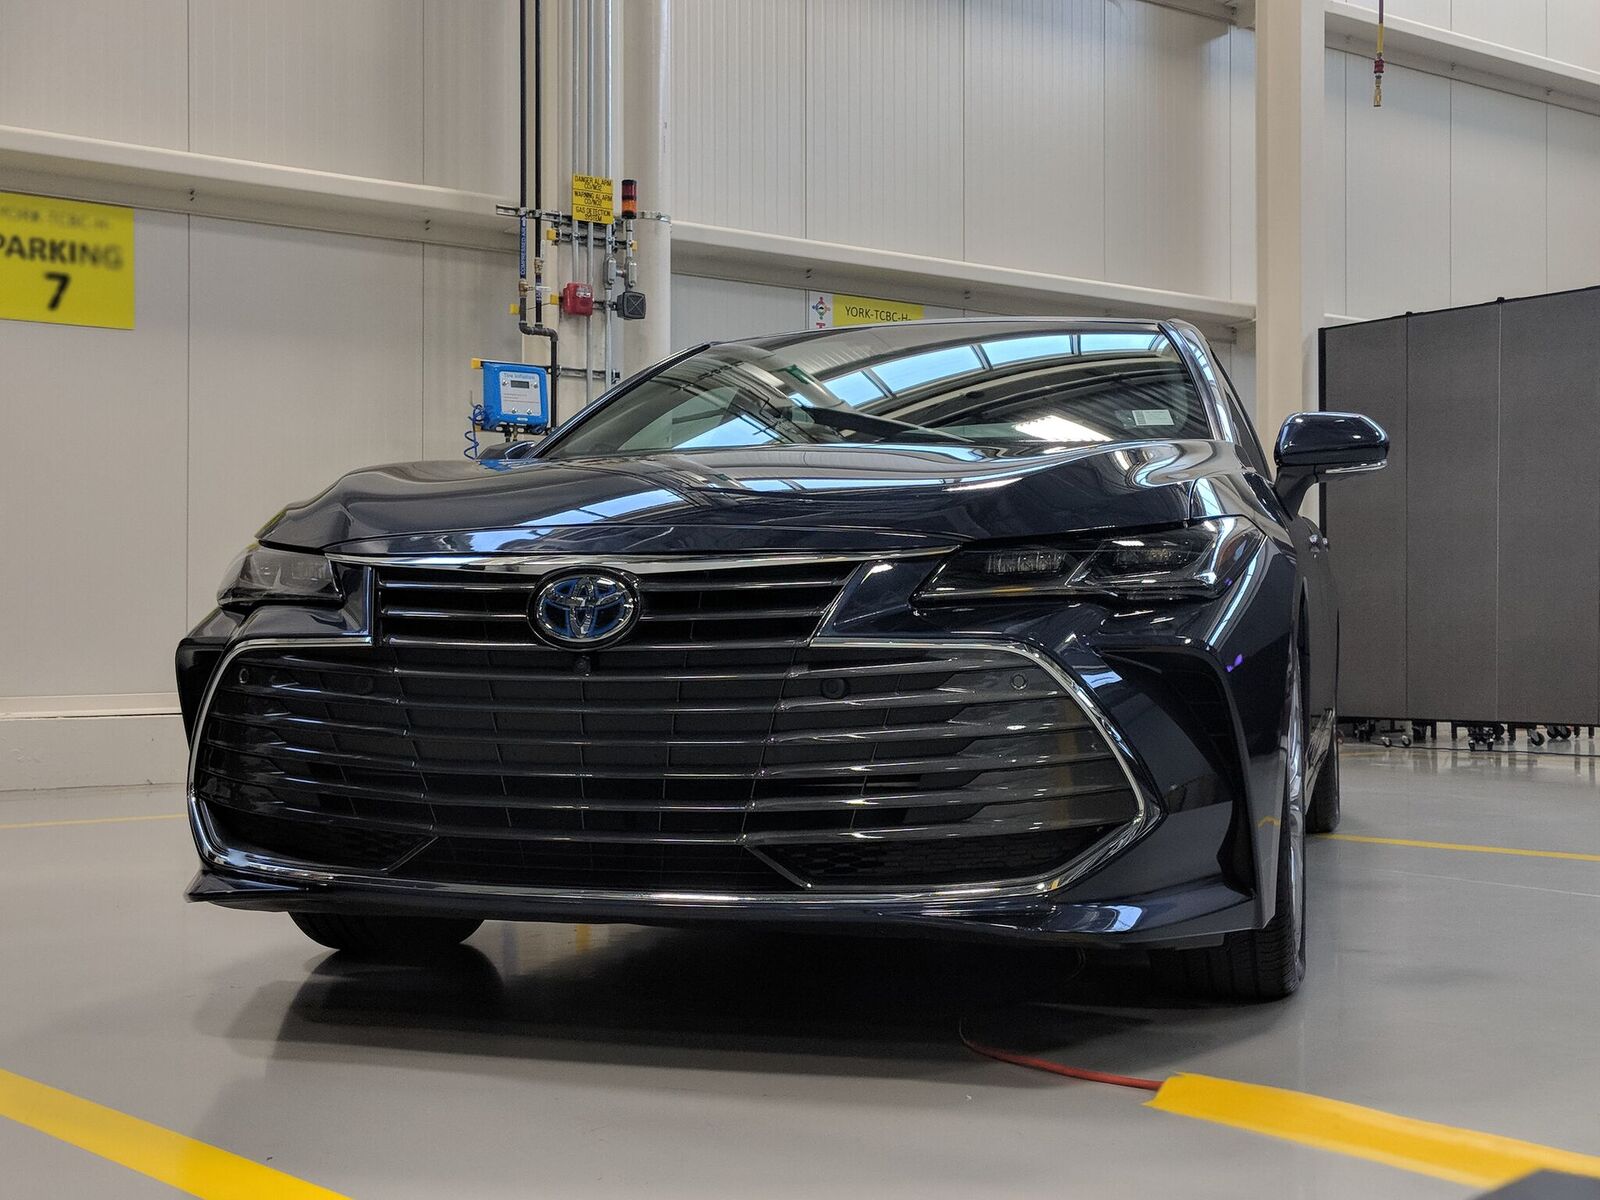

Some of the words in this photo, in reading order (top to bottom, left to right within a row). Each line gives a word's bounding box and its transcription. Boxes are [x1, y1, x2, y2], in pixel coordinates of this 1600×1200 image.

[574, 191, 594, 199] WARNING
[576, 206, 585, 214] GAS
[585, 208, 610, 216] DETECTION
[44, 271, 71, 311] 7
